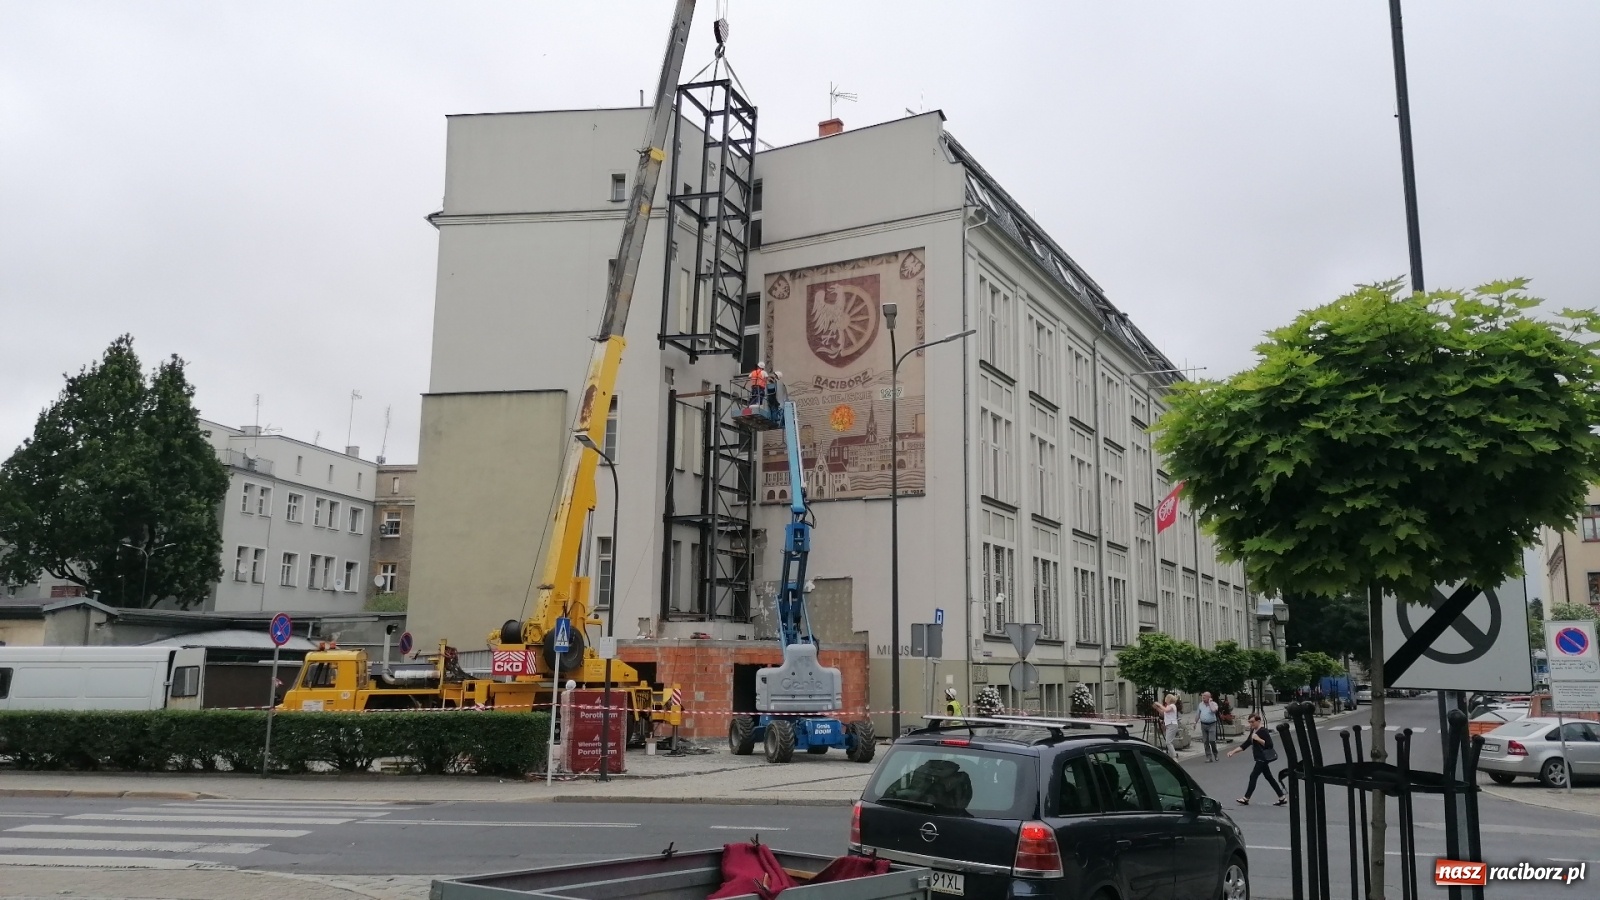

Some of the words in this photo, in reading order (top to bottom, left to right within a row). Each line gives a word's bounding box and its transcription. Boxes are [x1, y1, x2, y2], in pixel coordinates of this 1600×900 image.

[822, 390, 873, 404] MIEJSKIE
[880, 386, 902, 399] 127
[494, 661, 523, 672] CKD
[781, 677, 823, 690] Genie
[580, 711, 618, 719] Porothrm
[577, 748, 618, 756] Porothrm
